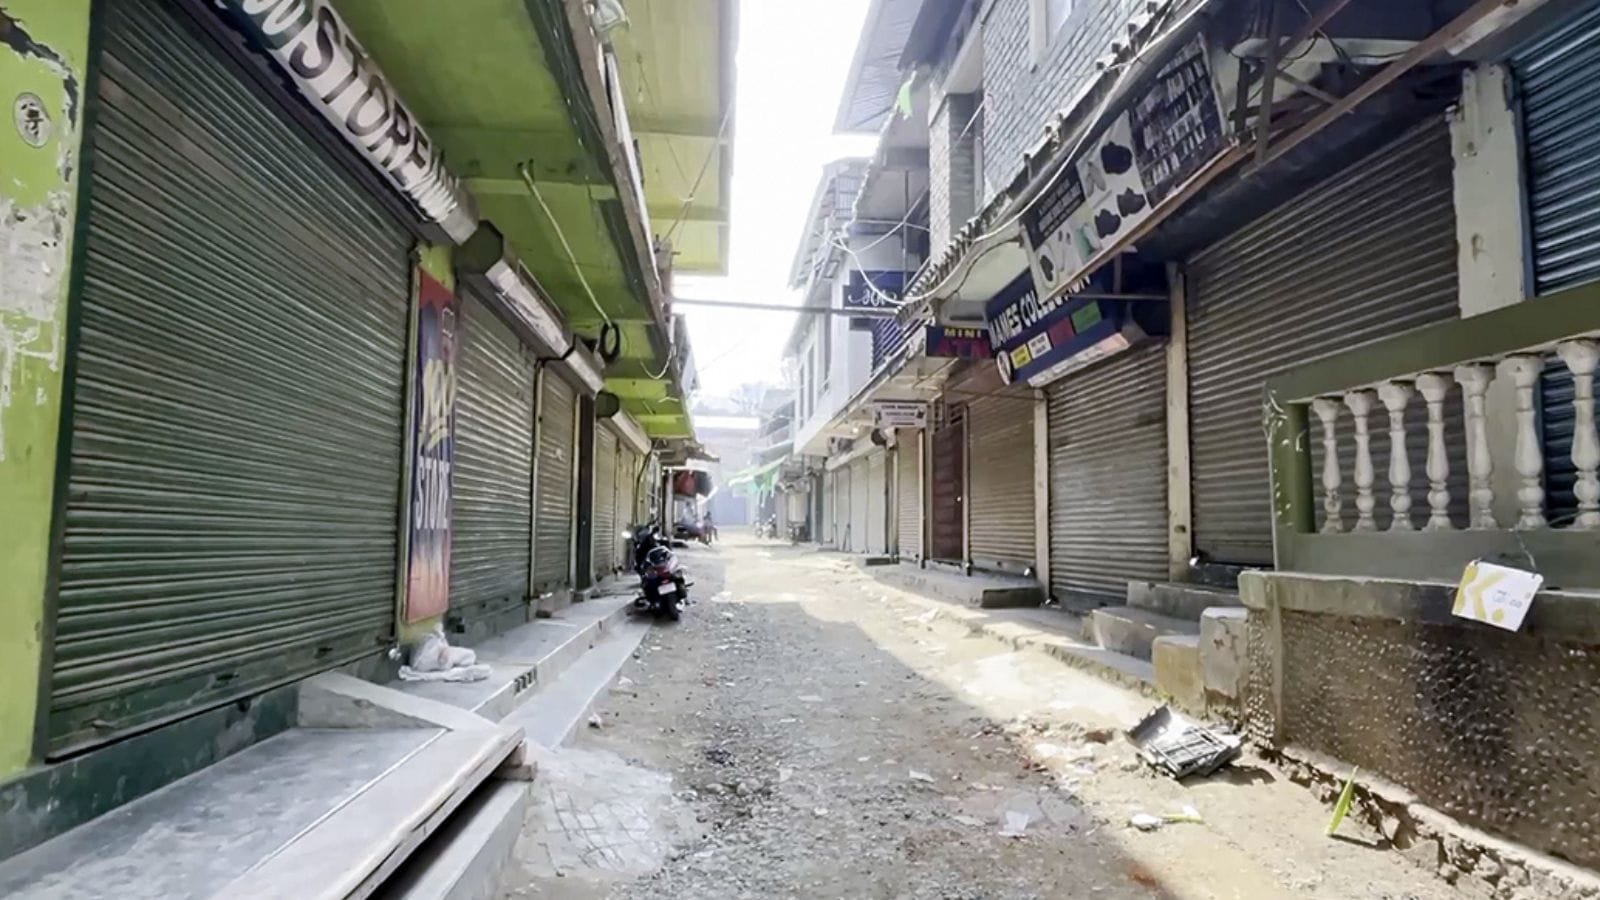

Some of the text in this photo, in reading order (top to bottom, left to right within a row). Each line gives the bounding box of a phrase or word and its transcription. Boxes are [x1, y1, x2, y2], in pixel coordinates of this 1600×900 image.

[289, 5, 429, 187] STORE
[1020, 272, 1091, 328] COLON
[944, 328, 982, 339] MINI
[415, 456, 450, 529] STORE
